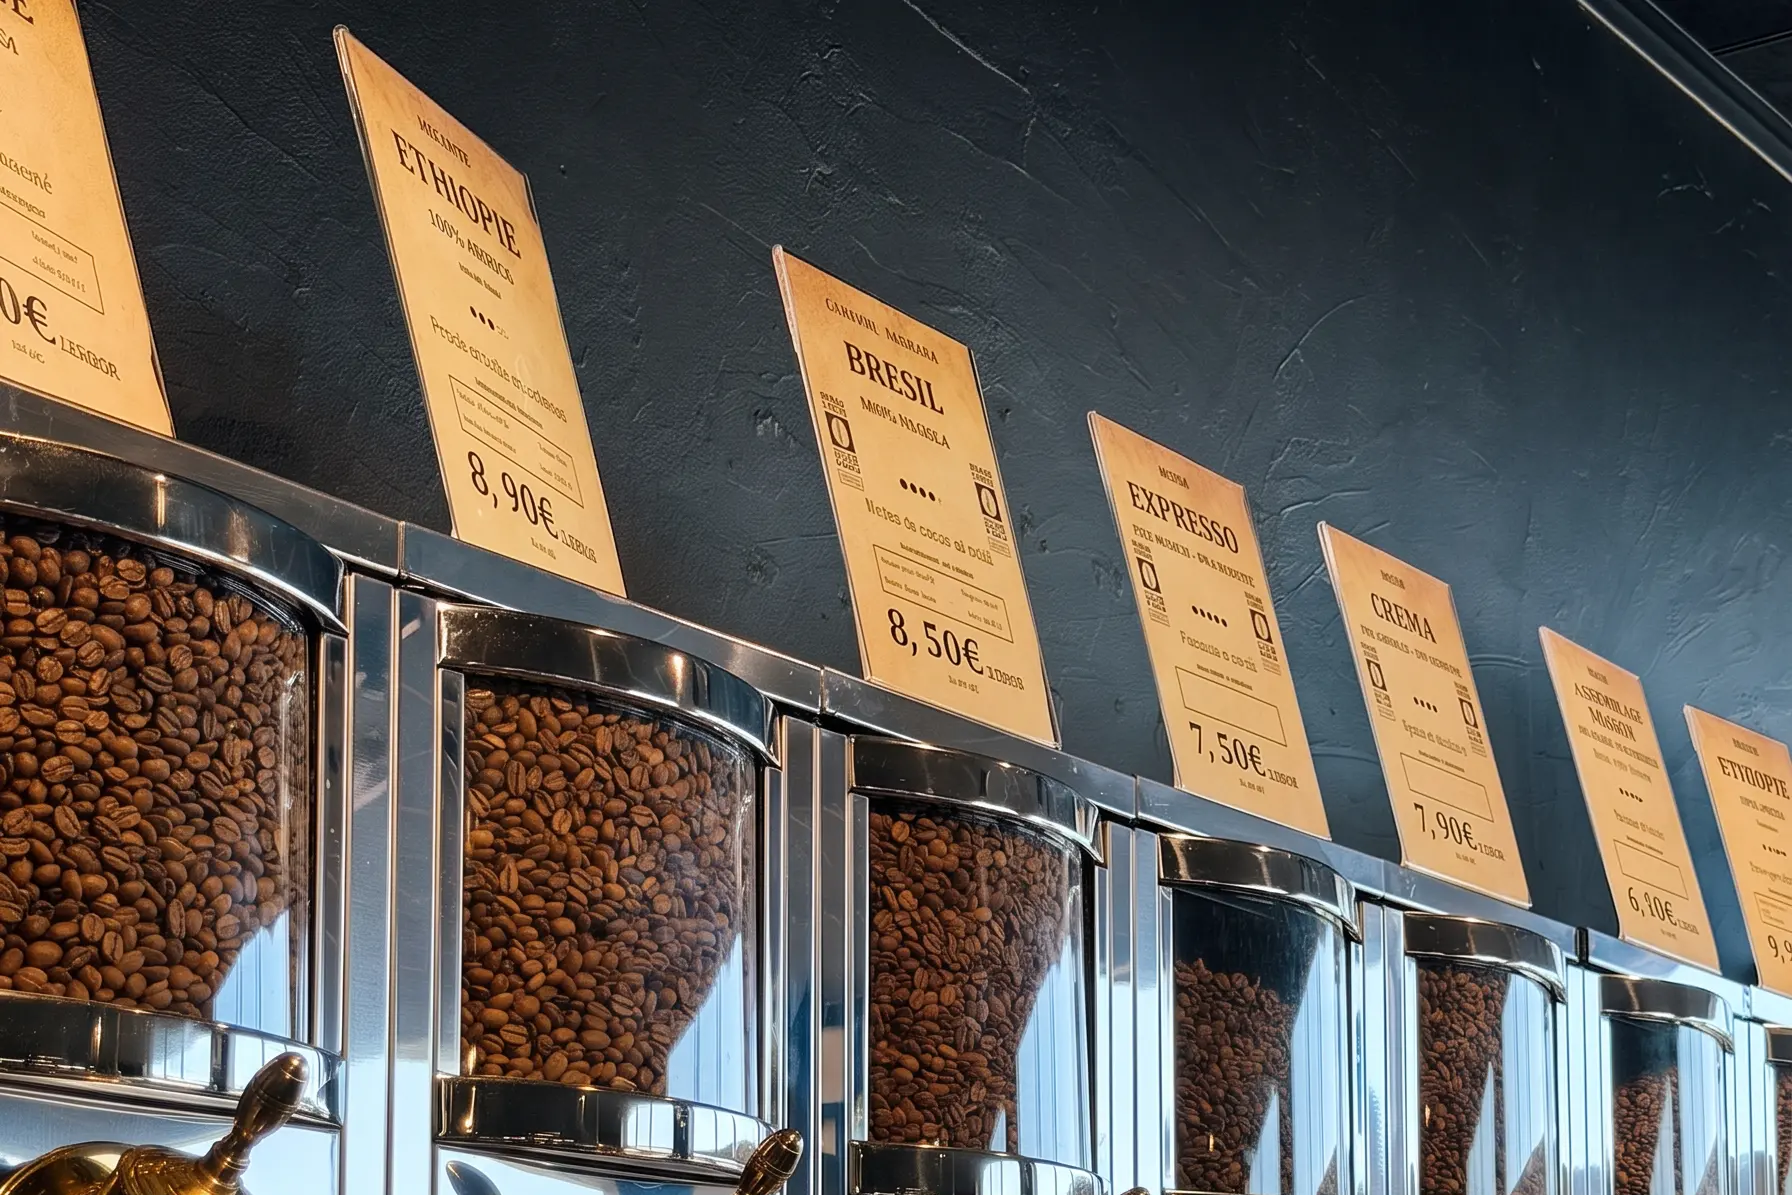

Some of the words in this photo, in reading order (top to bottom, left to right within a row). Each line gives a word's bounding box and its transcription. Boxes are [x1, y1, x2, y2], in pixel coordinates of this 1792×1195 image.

[390, 128, 521, 259] ETHIOPIE
[843, 340, 945, 416] BRESIL
[467, 451, 558, 539] 8,90€
[1126, 480, 1239, 554] EXPRESSO
[887, 608, 983, 675] 8,50€
[1370, 592, 1437, 644] CREMA
[1189, 721, 1266, 777] 7,50€
[1413, 802, 1477, 850] 7,90€
